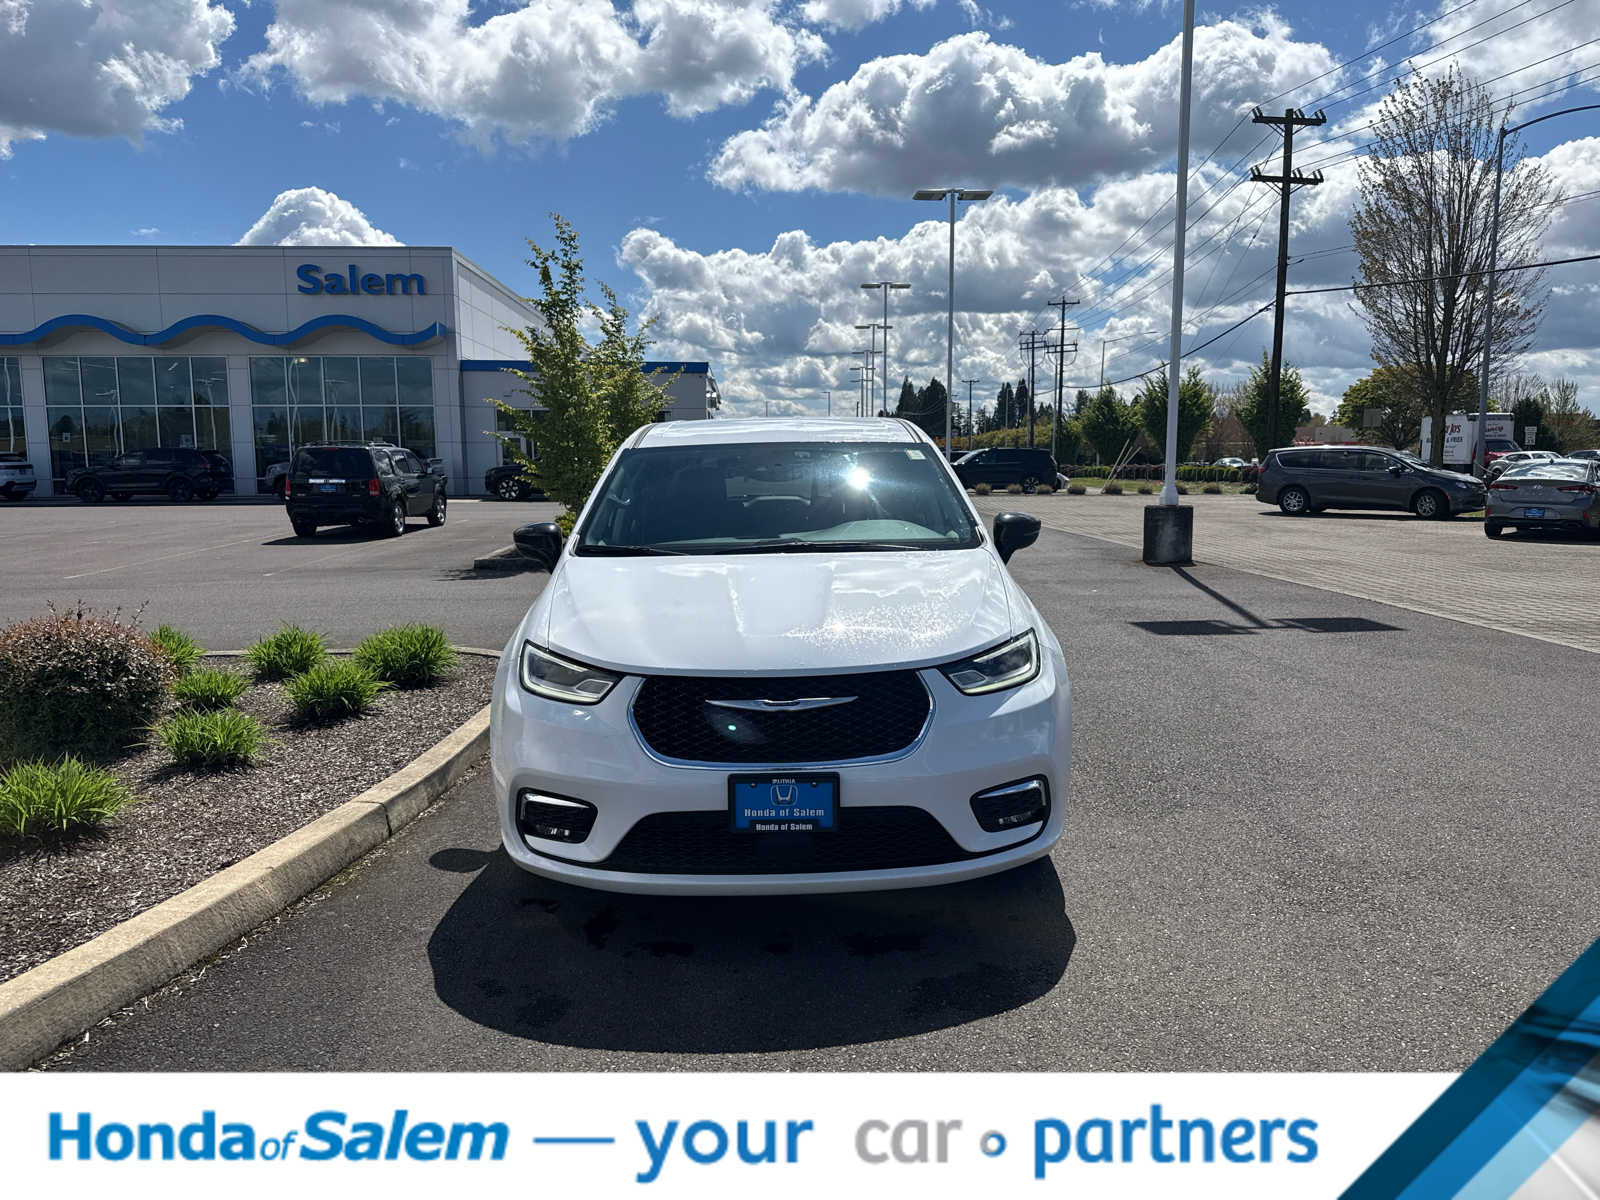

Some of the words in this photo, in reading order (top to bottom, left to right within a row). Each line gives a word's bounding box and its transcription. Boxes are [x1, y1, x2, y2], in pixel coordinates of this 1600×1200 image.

[297, 264, 425, 295] Salem
[744, 808, 776, 816] Honda
[780, 808, 790, 816] of
[793, 808, 825, 817] Salem
[756, 823, 779, 831] Honda
[781, 823, 788, 831] of
[790, 823, 813, 831] Salem
